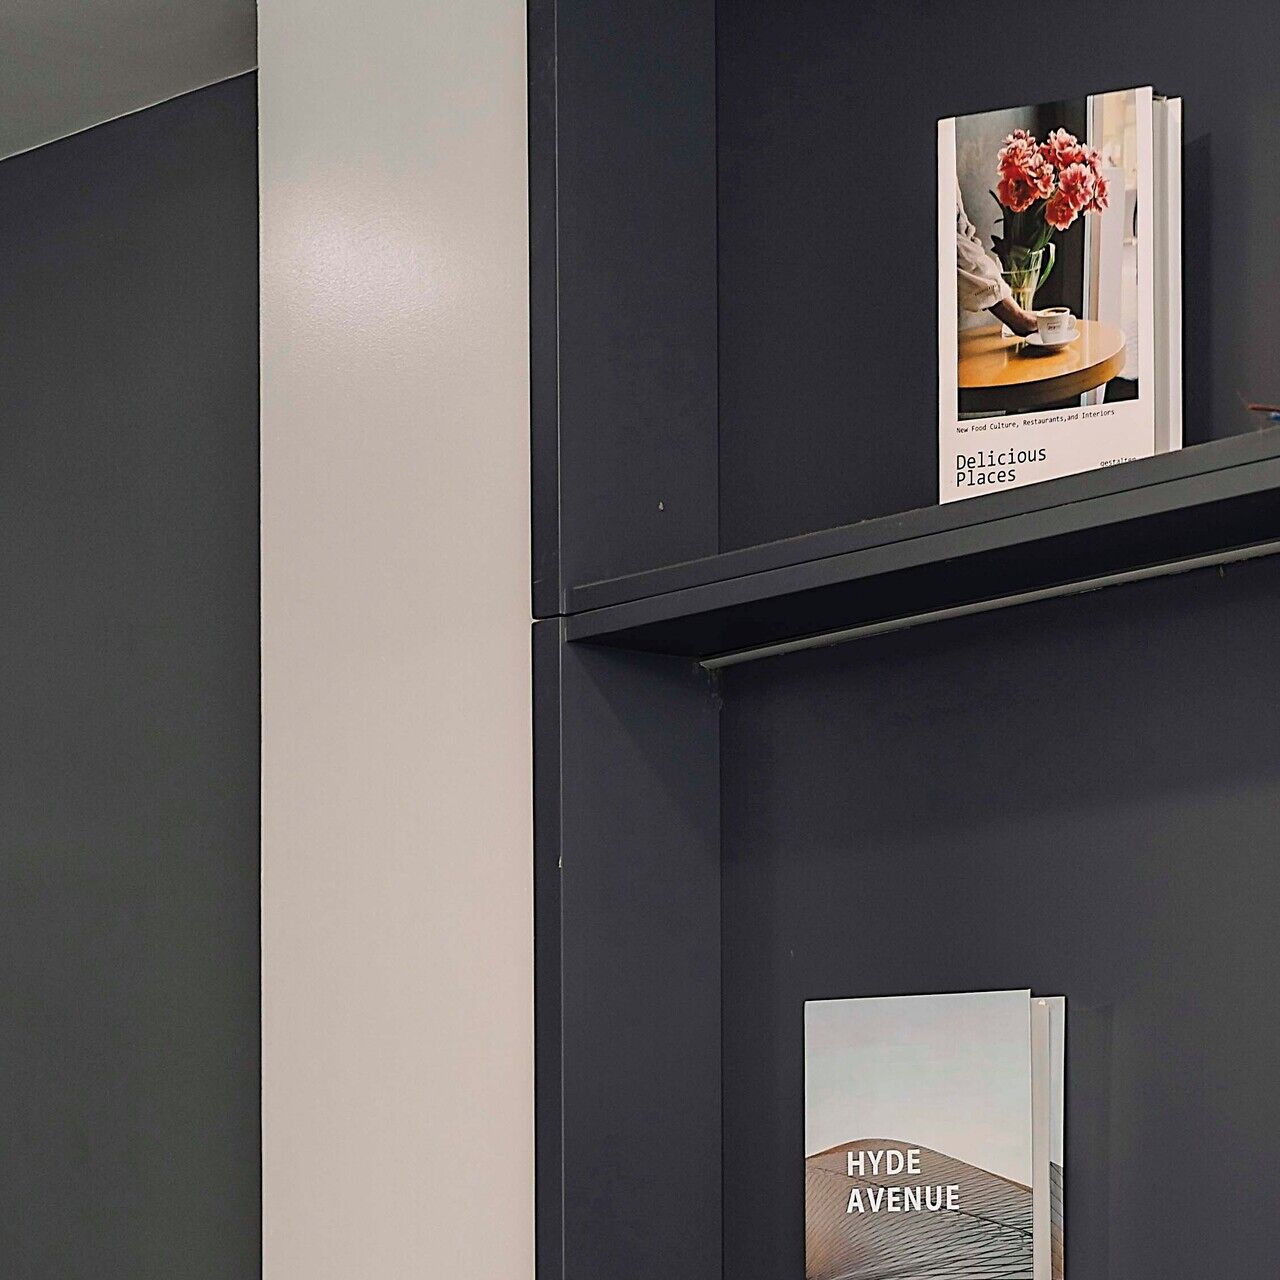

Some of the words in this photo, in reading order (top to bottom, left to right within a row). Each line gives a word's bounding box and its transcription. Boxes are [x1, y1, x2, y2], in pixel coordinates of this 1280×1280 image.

[971, 424, 987, 432] Food
[989, 421, 1019, 430] Culture,
[1082, 409, 1115, 419] Interiors
[956, 448, 1047, 470] Delicious
[956, 468, 1017, 488] Places
[847, 1148, 921, 1176] HYDE
[846, 1184, 960, 1214] AVENUE
